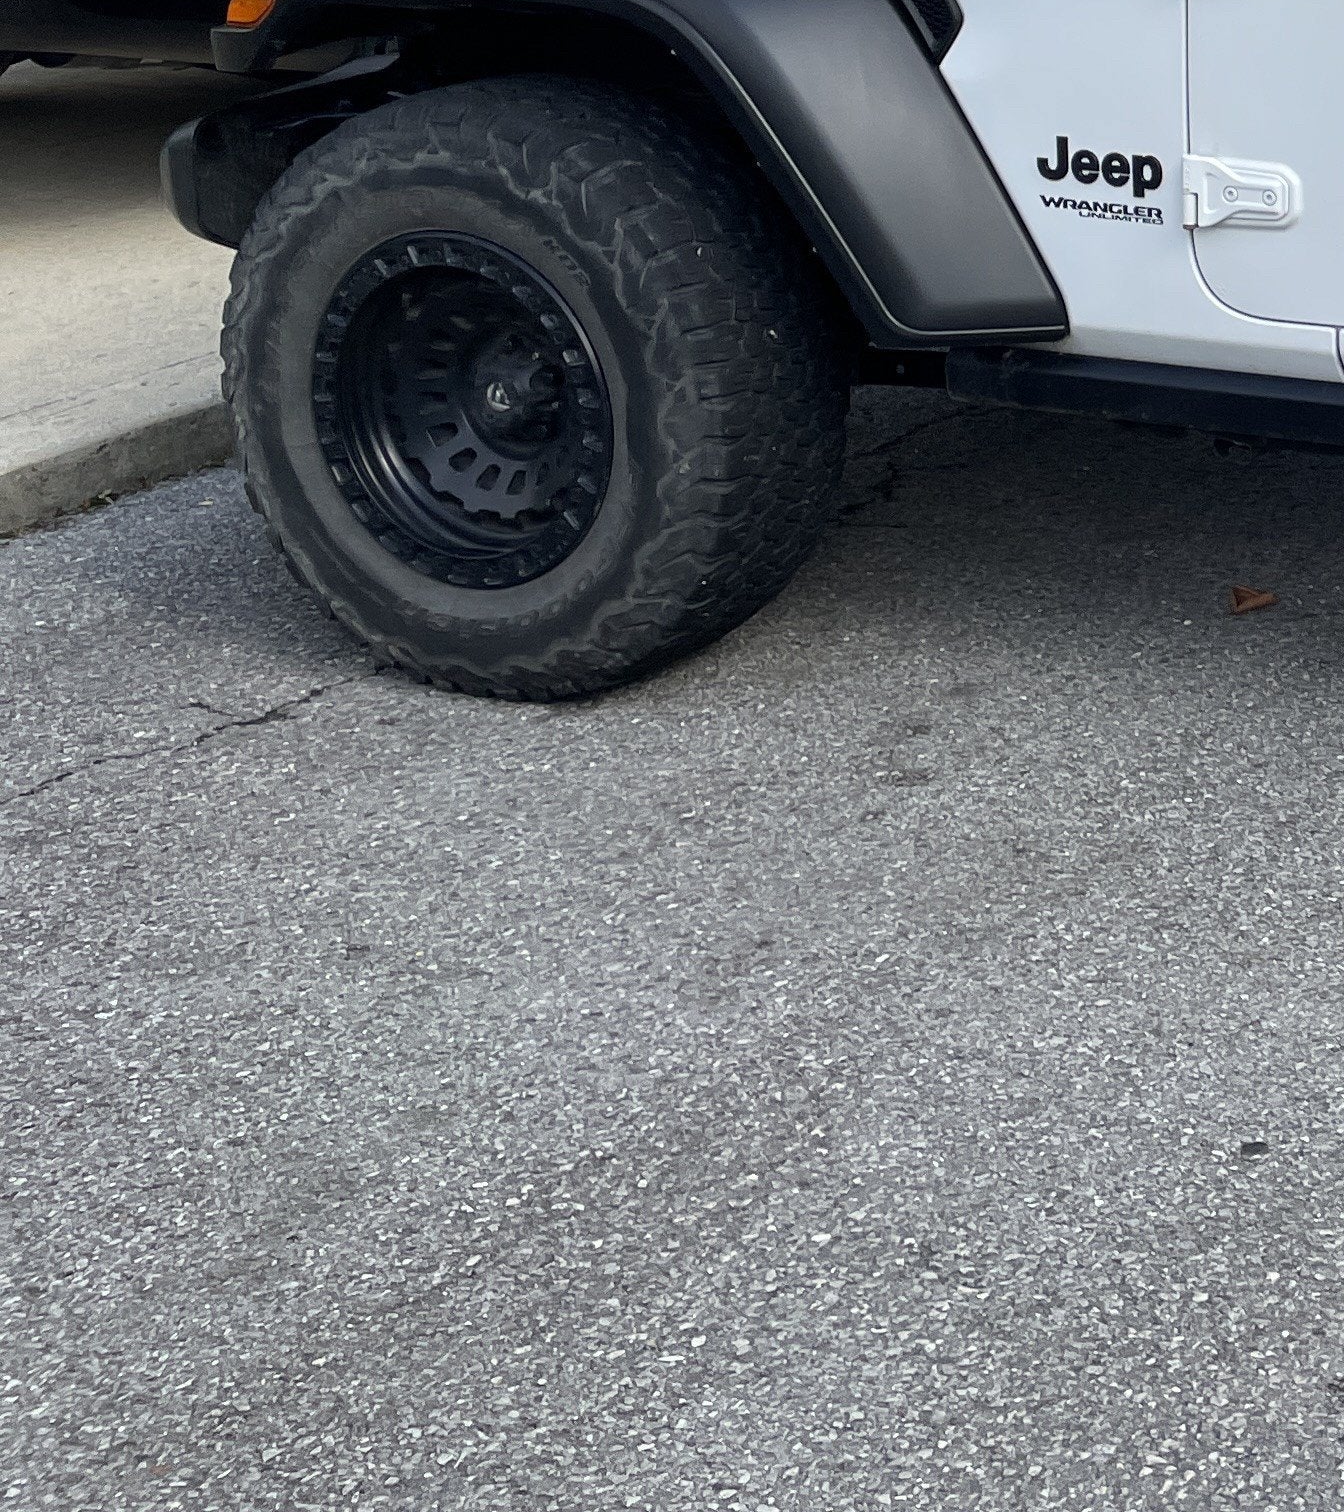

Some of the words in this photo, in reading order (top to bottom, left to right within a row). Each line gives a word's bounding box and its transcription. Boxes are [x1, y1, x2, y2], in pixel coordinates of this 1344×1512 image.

[1036, 135, 1163, 198] Jeep
[1039, 194, 1163, 219] WRANGLER
[1078, 210, 1164, 226] UNLIMITED
